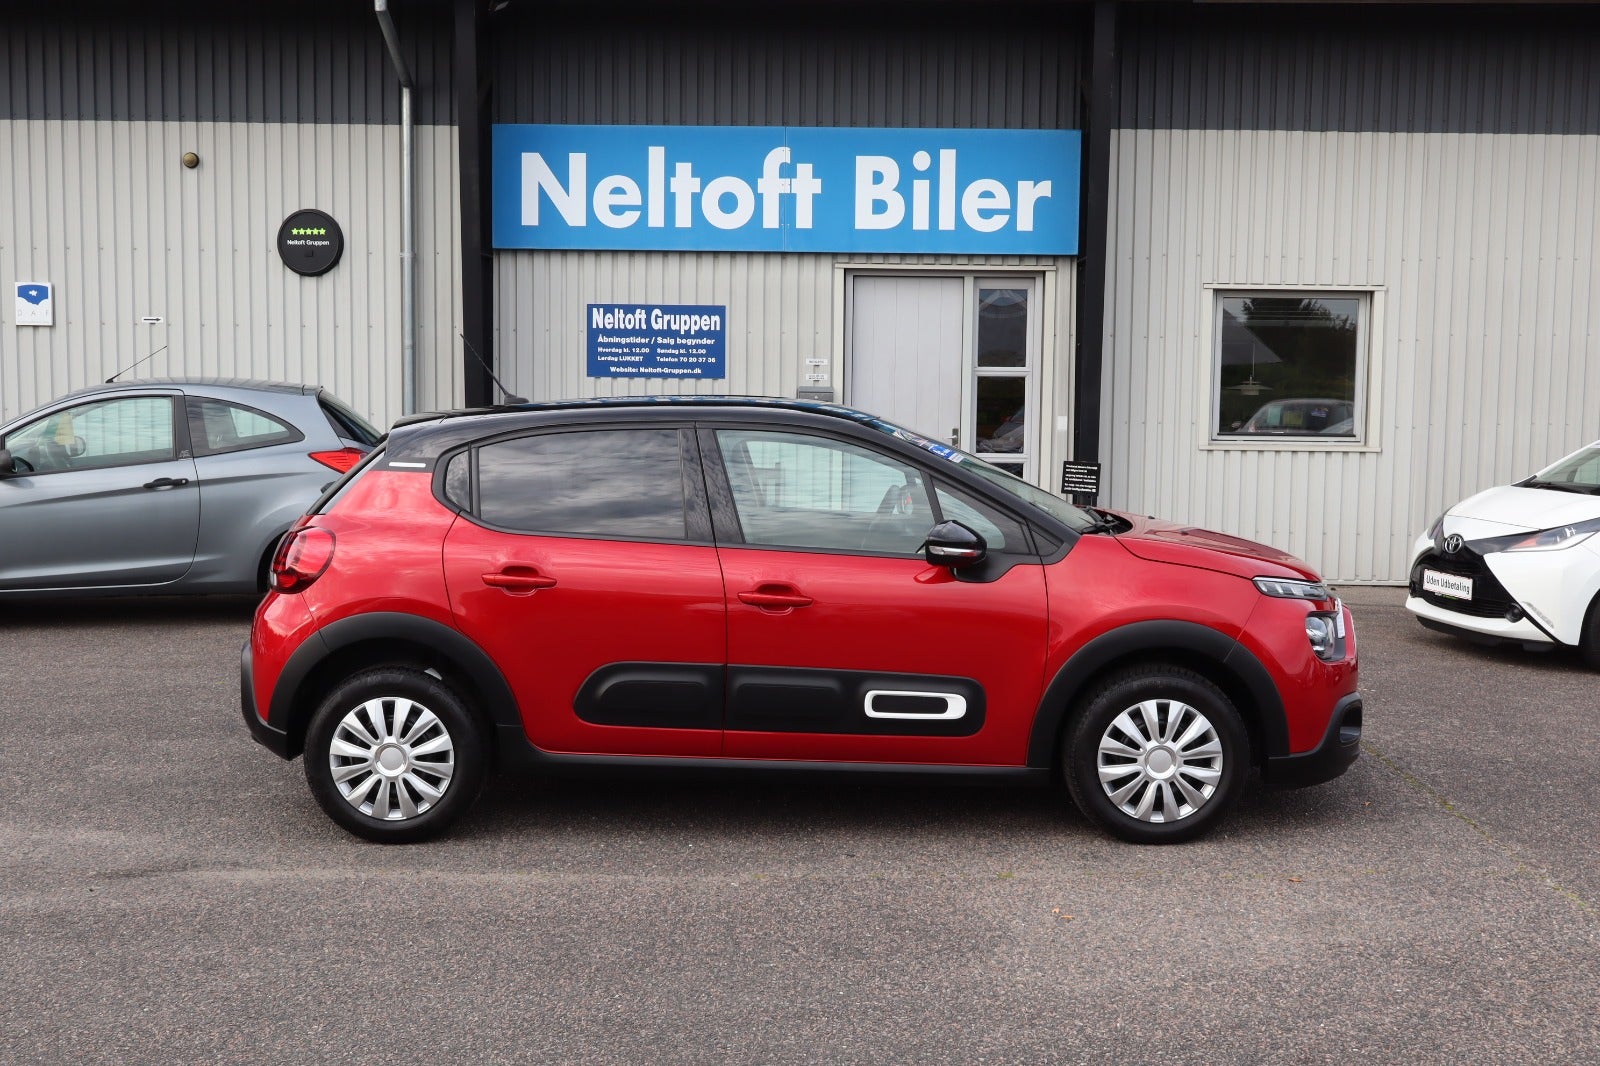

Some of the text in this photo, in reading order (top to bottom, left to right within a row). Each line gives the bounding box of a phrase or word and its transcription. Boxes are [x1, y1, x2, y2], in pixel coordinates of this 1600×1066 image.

[521, 146, 1052, 233] Neltoft Biler
[593, 308, 720, 334] Neltoft Gruppen
[597, 334, 716, 346] Åbningstider / Salg begynder
[656, 347, 679, 355] Søndag
[639, 367, 702, 375] Neltoft-Gruppen.dk
[1426, 575, 1470, 595] Uden Udbetaling
